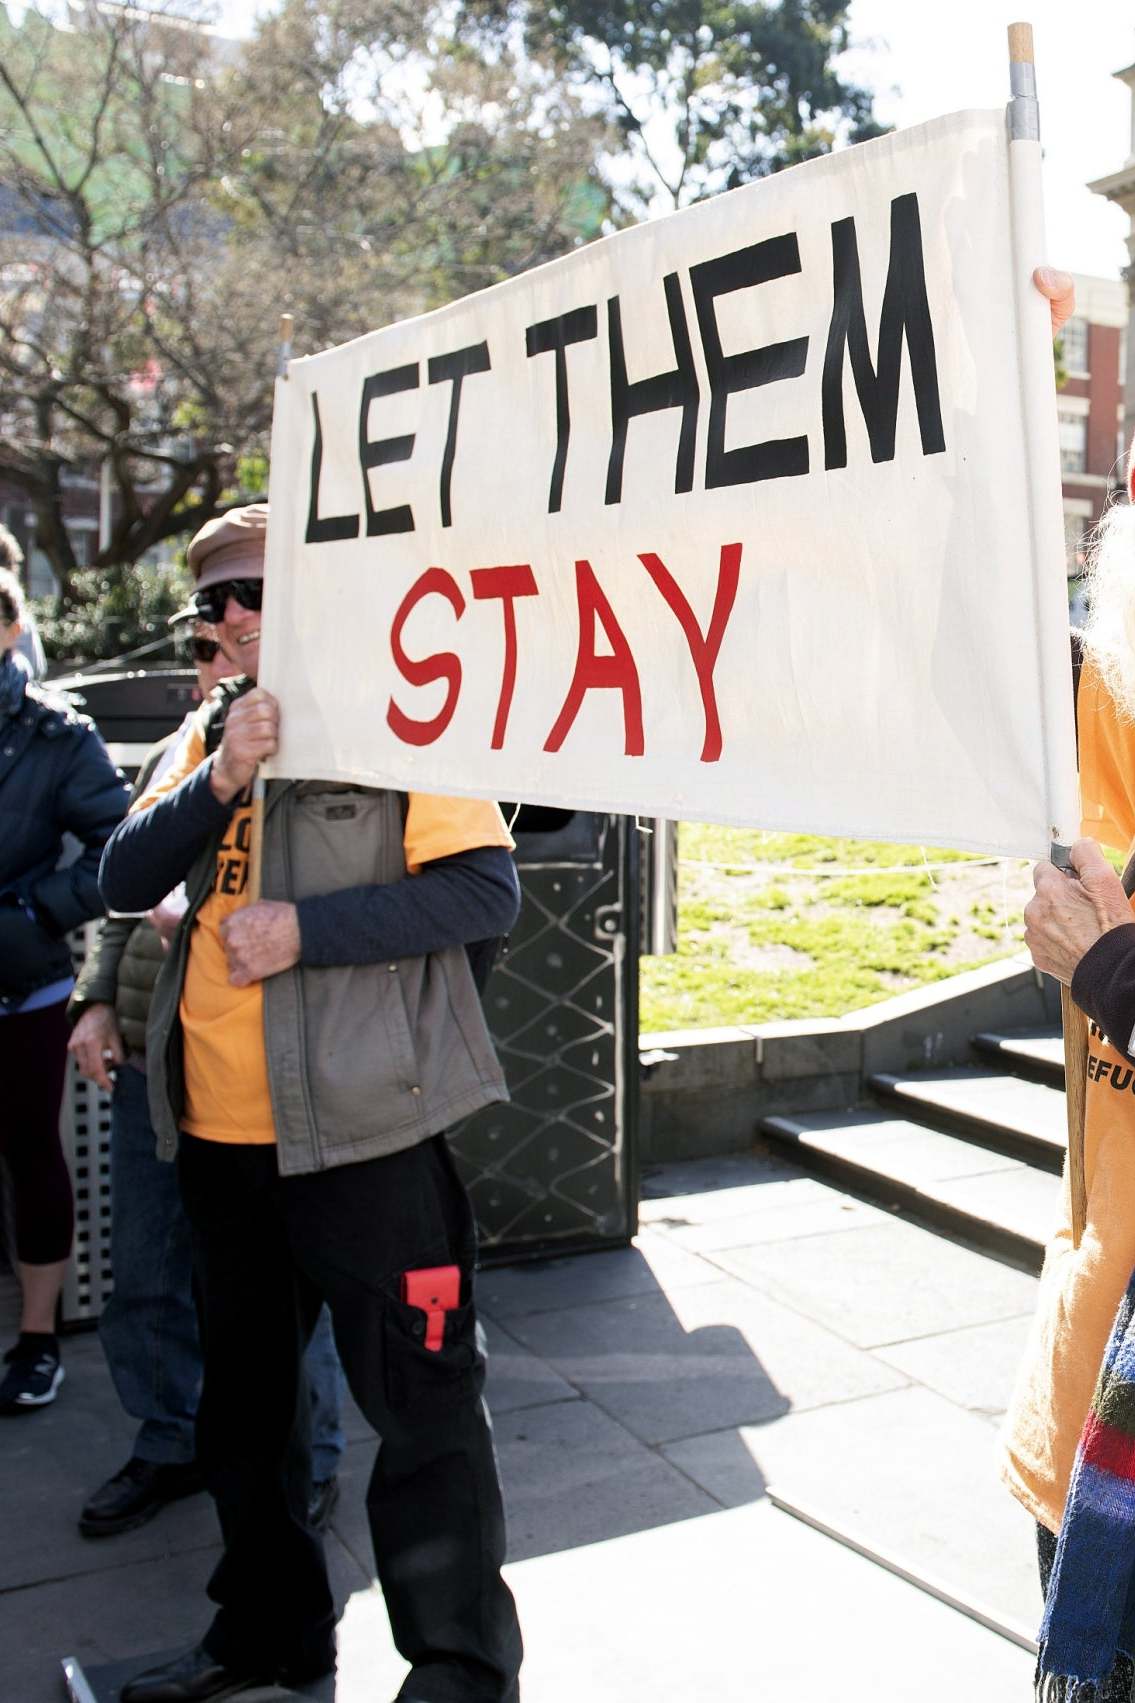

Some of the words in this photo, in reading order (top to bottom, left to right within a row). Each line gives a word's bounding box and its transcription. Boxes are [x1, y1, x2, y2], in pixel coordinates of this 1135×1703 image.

[306, 340, 492, 544] LET
[526, 192, 946, 514] THEM
[386, 542, 744, 763] STAY
